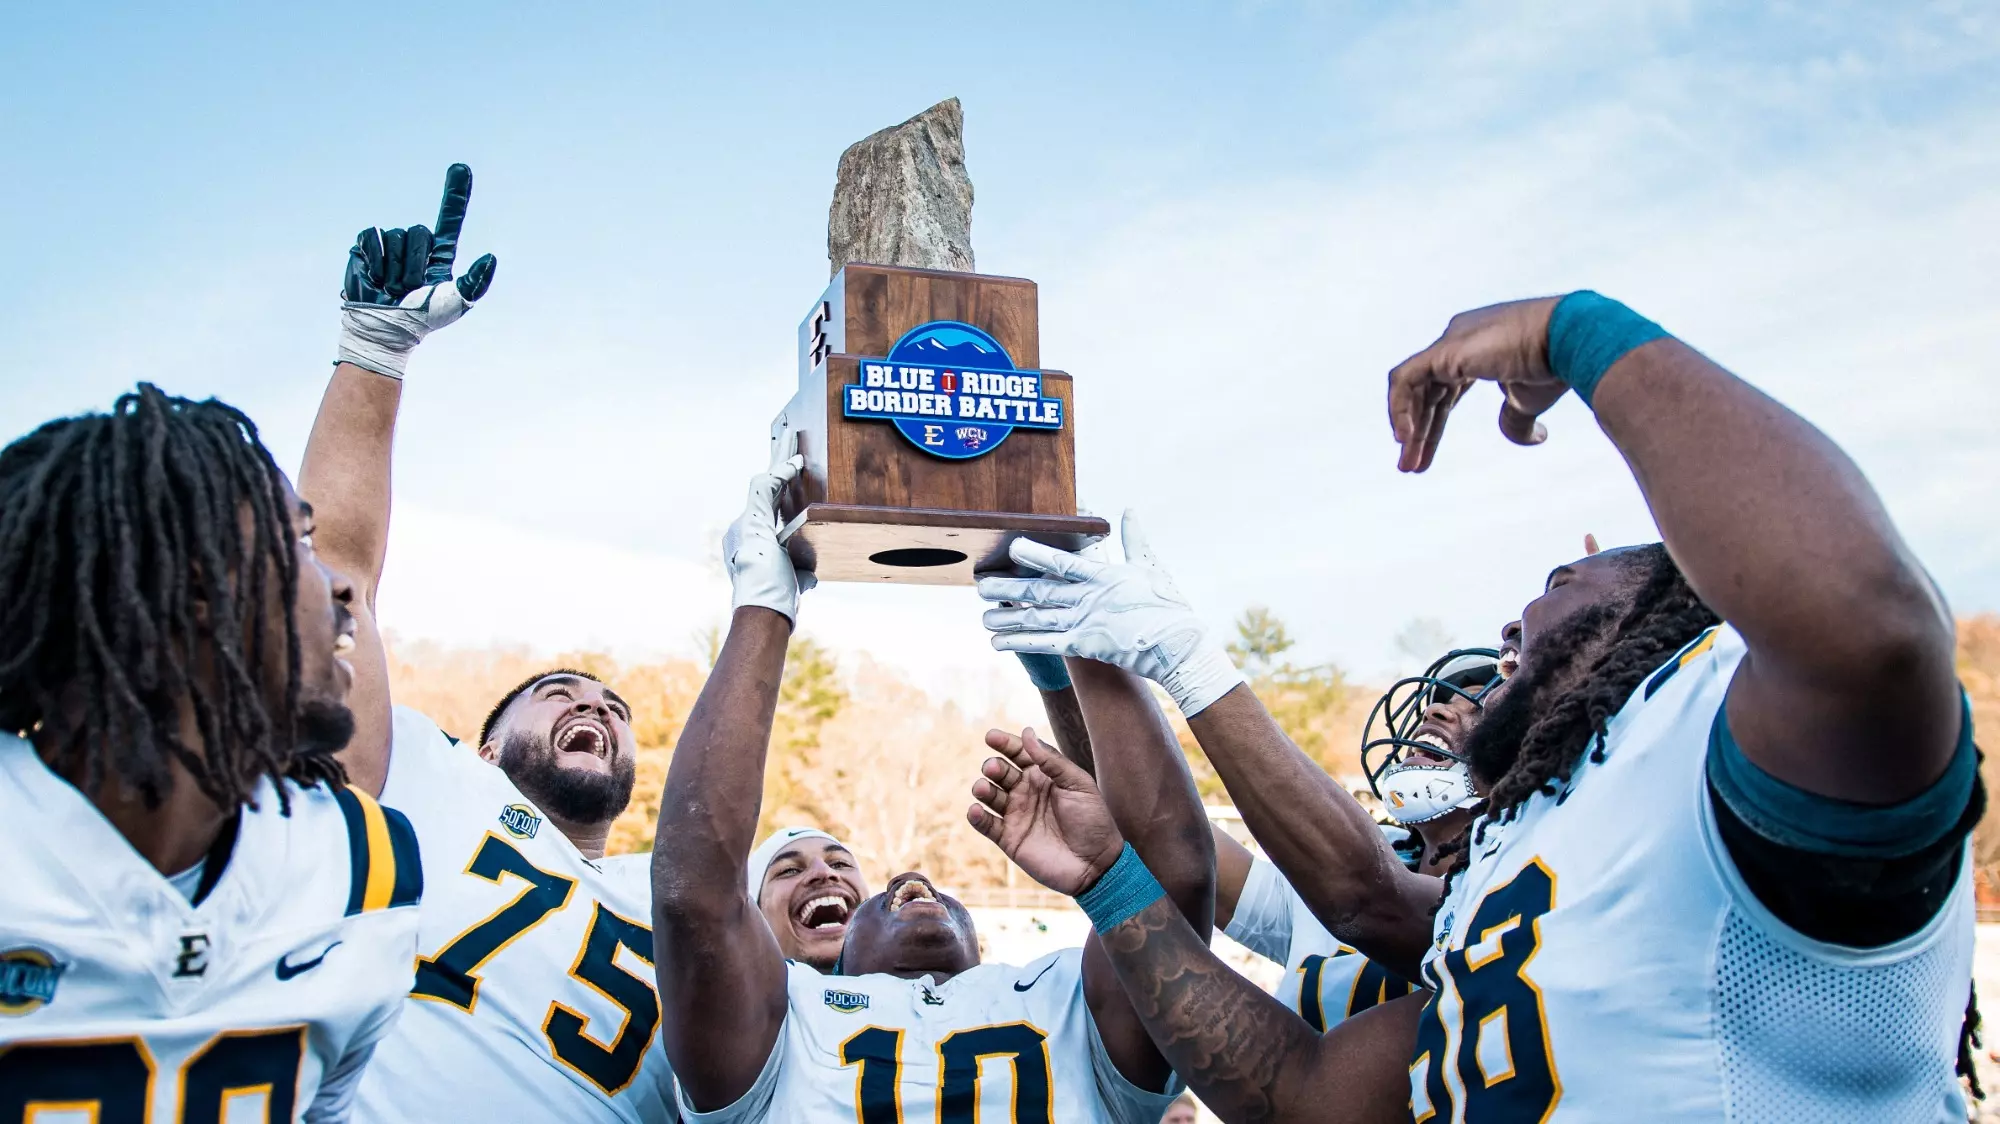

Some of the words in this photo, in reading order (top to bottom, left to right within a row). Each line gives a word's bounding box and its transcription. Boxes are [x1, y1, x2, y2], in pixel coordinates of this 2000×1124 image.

[866, 365, 935, 392] BLUE
[961, 371, 1038, 399] RIDGE
[850, 389, 953, 416] BORDER
[958, 396, 1060, 424] BATTLE
[924, 425, 945, 446] E
[955, 427, 988, 441] WCU
[500, 806, 541, 838] SOCON
[172, 934, 211, 979] E
[408, 829, 662, 1098] 75
[825, 989, 868, 1007] SOCON
